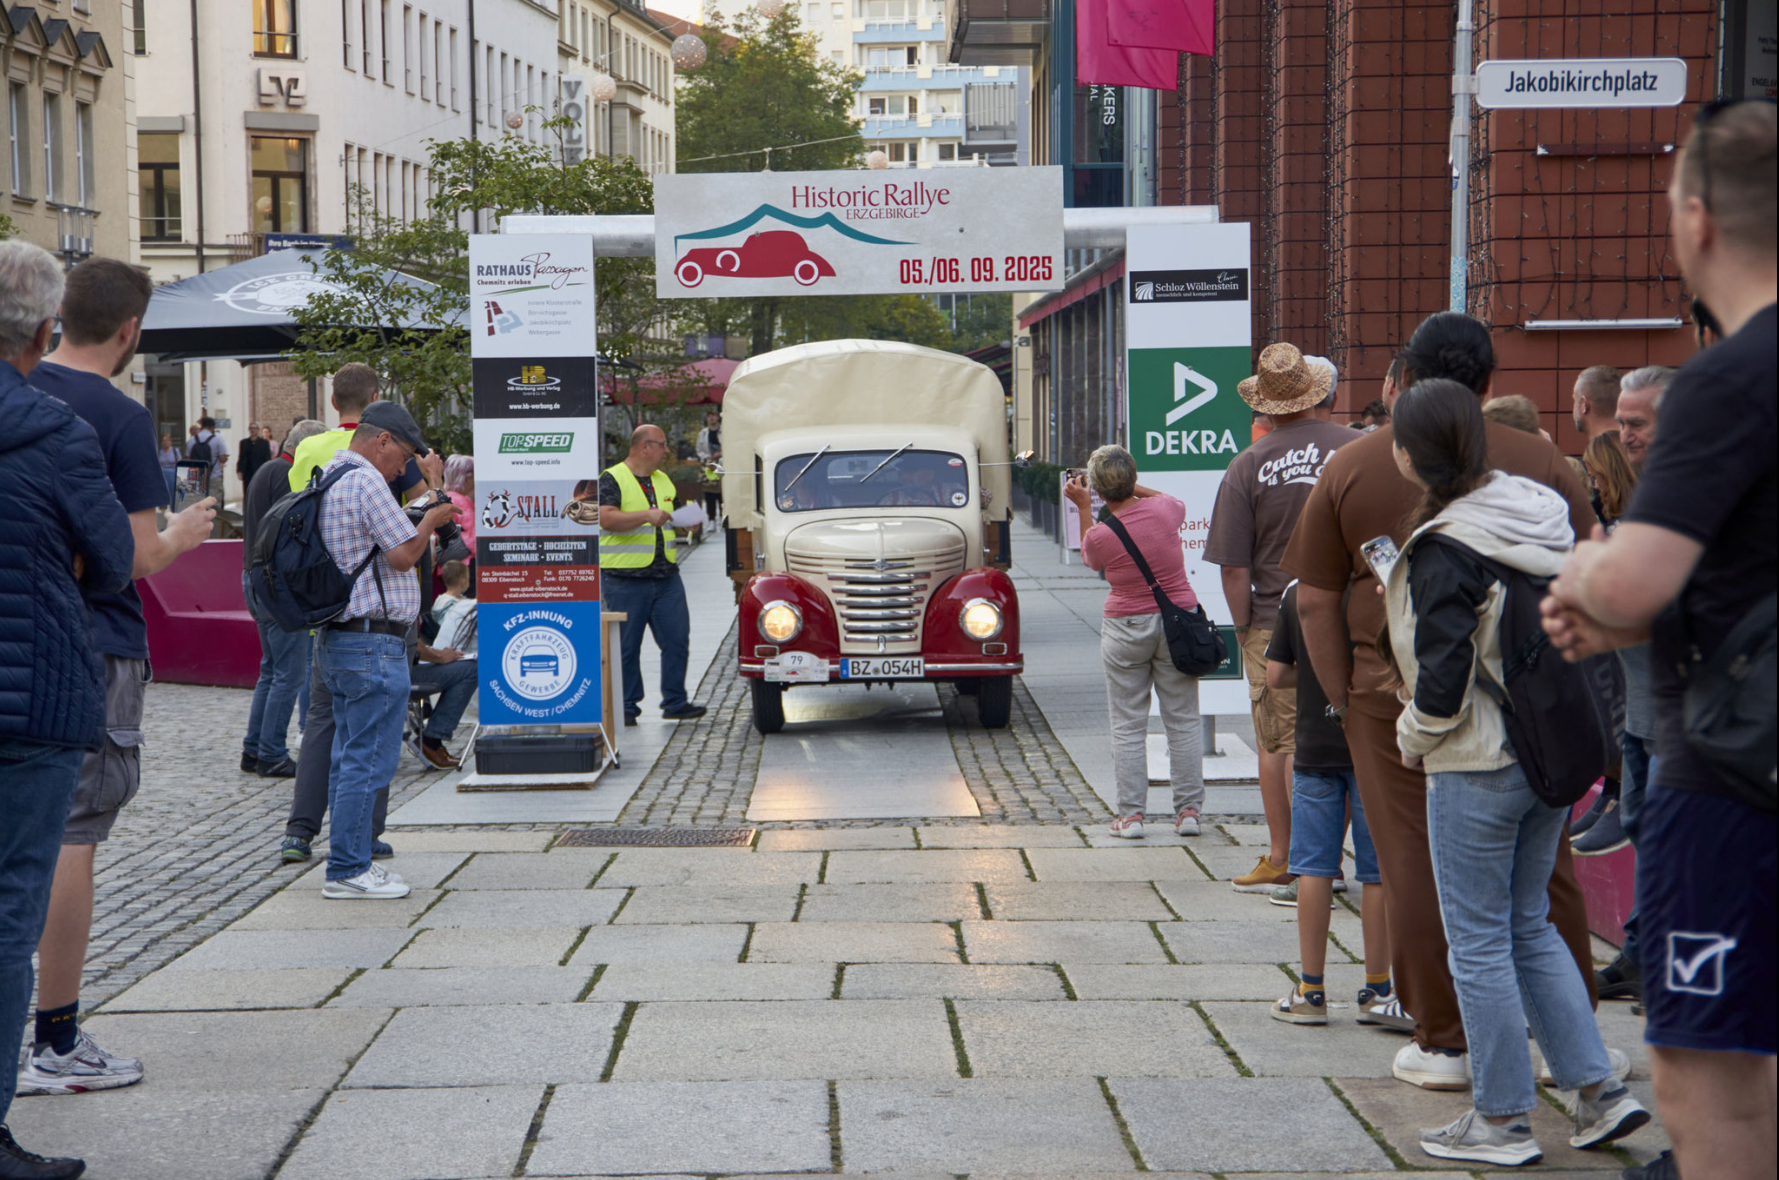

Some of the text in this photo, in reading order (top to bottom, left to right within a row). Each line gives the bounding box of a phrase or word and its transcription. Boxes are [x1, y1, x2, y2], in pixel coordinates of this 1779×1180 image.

[1505, 69, 1658, 97] Jakobikirchplatz
[1090, 84, 1098, 101] IAL
[1103, 87, 1116, 125] KERS
[791, 181, 950, 215] Historic Rallye
[845, 207, 921, 221] ERZGEBIRGE
[267, 239, 282, 247] Ihre
[476, 264, 531, 277] RATHAUS
[900, 255, 1053, 286] 05./06. 09. 2025
[247, 277, 280, 289] ICE
[1155, 281, 1239, 292] Schloz Wöllenstein
[521, 365, 547, 384] HB
[508, 402, 561, 410] www.hb-werbung.de
[1145, 429, 1239, 456] DEKRA
[1258, 442, 1320, 483] Catch
[1282, 464, 1312, 481] you
[488, 541, 587, 551] GEBURTSTAGE HOCHZEITEN
[503, 552, 573, 562] SEMINARE EVENTS
[502, 610, 574, 632] KFZ-INNUNG
[510, 633, 569, 661] KRAFTFAHRZEUG
[790, 655, 803, 665] 79
[851, 660, 871, 676] BZ
[881, 659, 922, 675] 054H
[519, 679, 561, 694] GEWERBE
[489, 679, 523, 714] SACHSEN
[524, 708, 550, 718] WEST
[555, 677, 592, 714] CHEMNITZ
